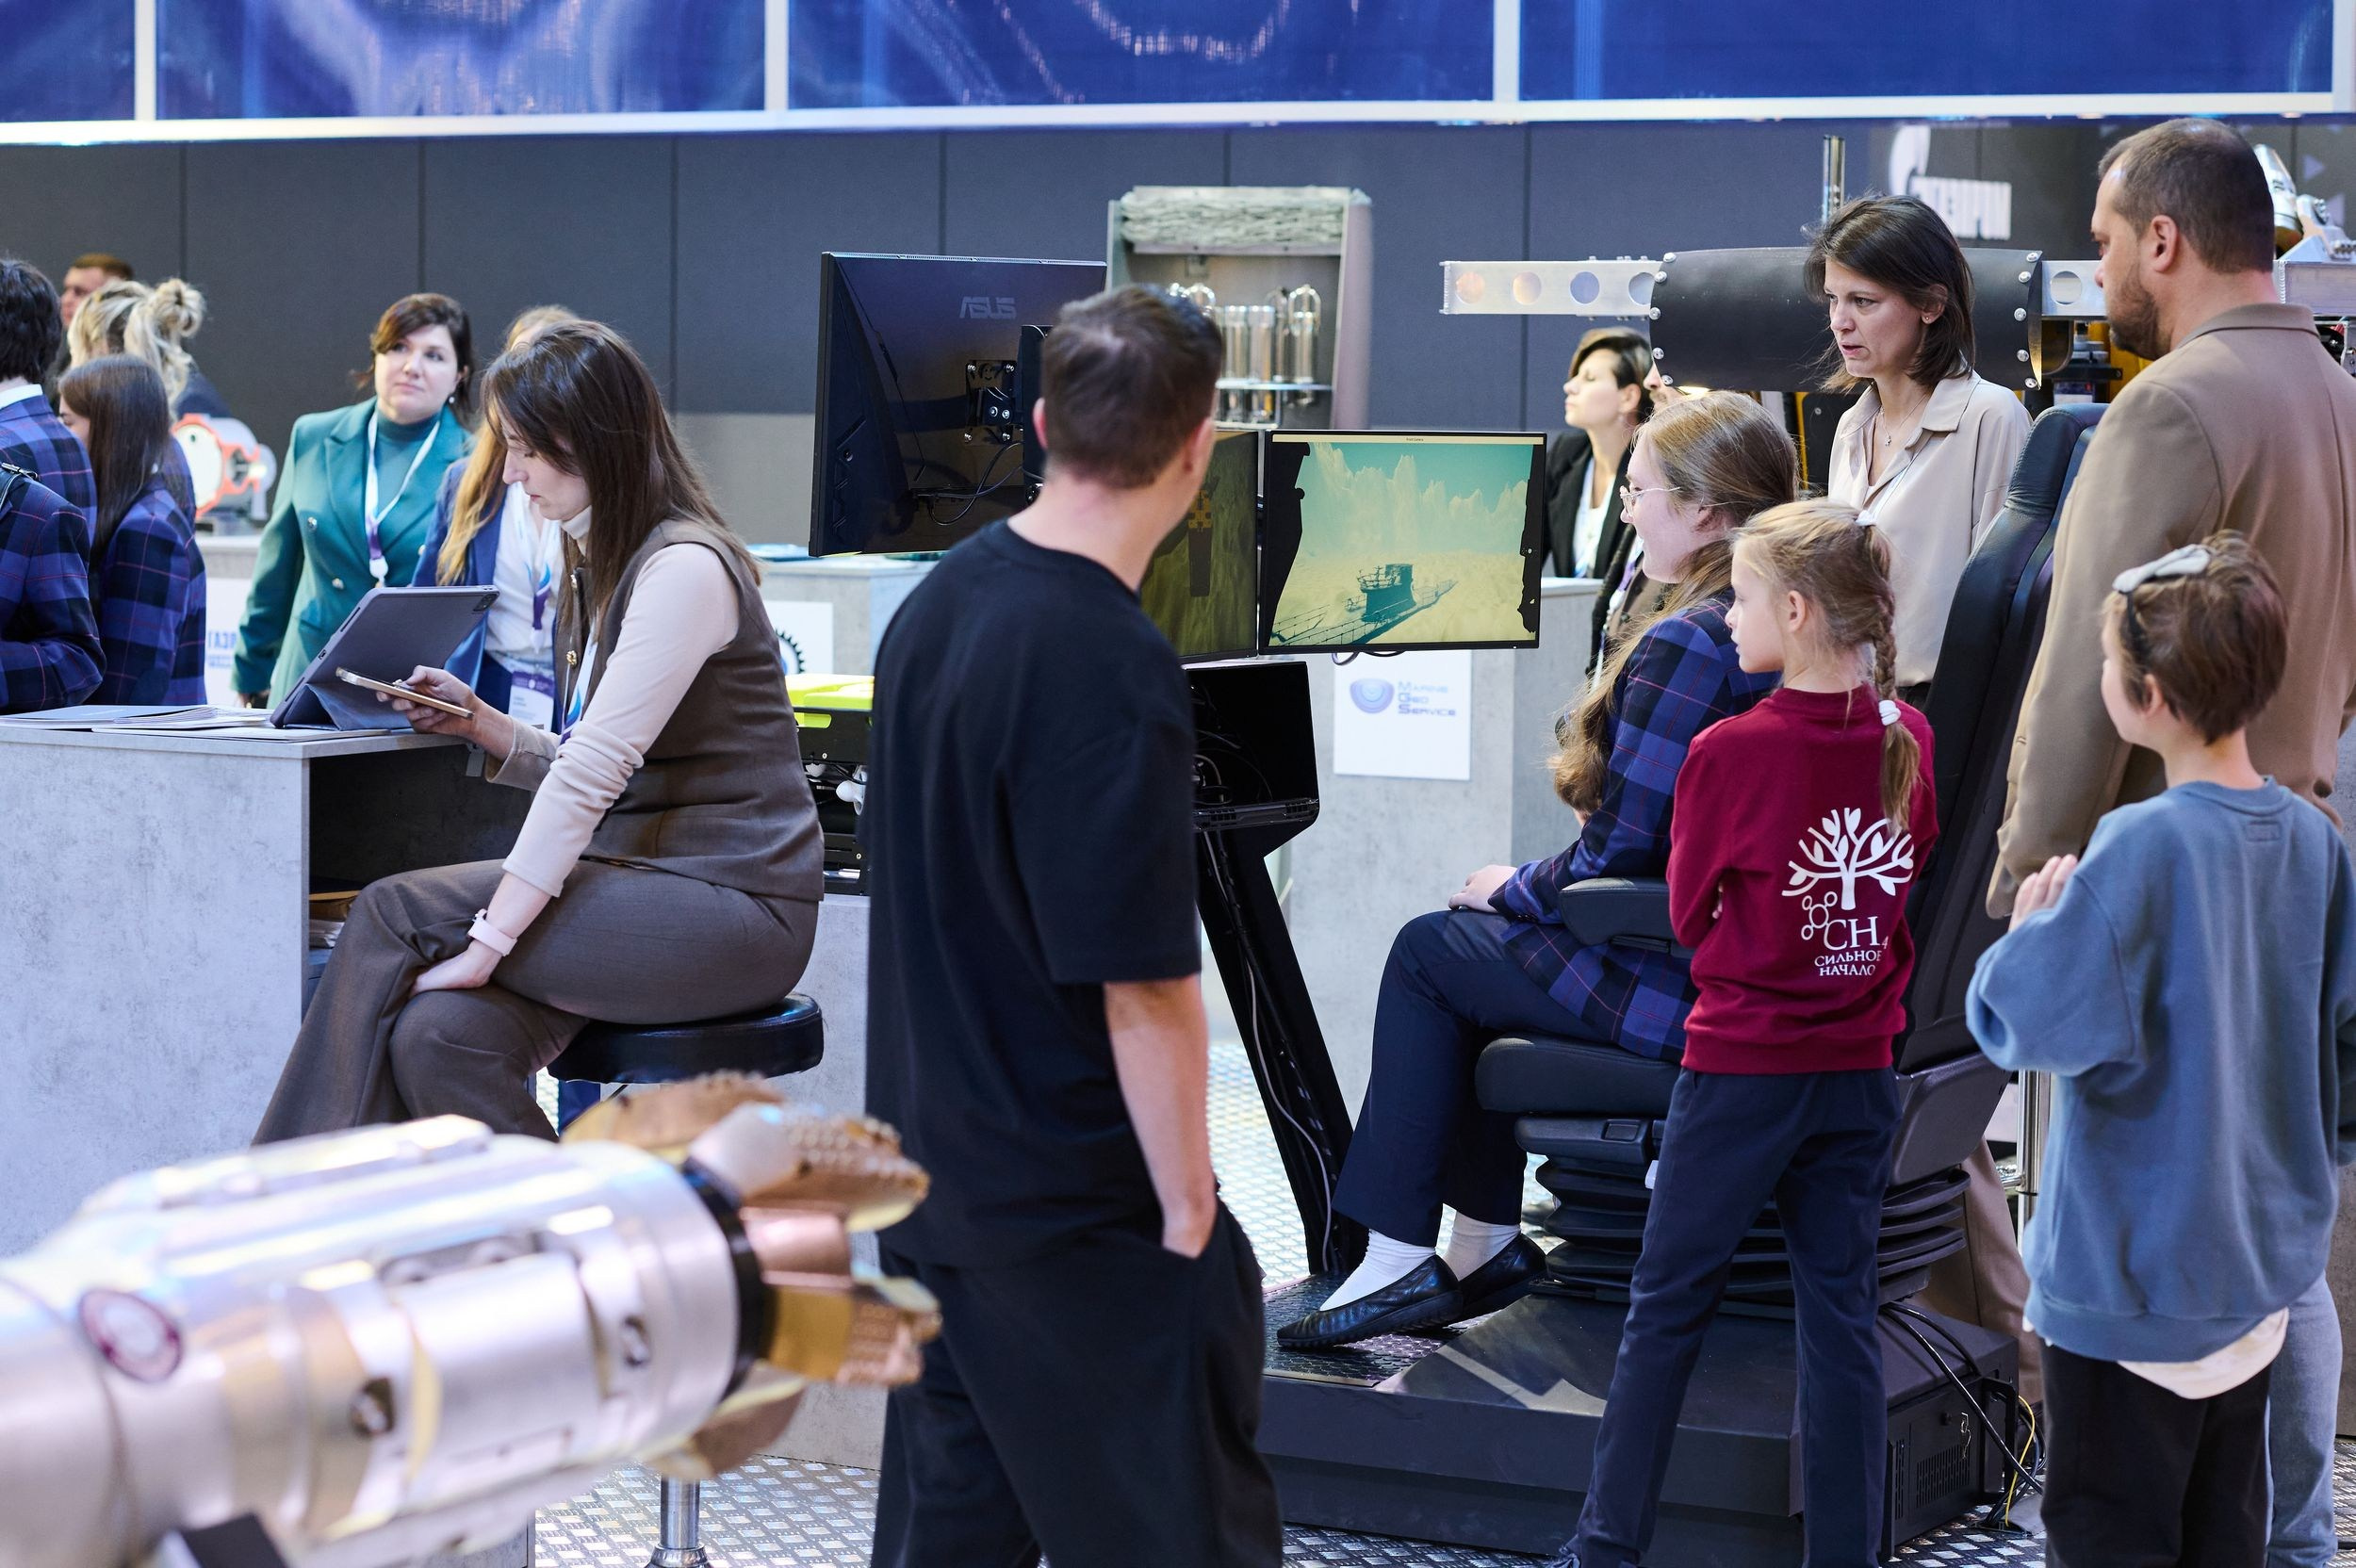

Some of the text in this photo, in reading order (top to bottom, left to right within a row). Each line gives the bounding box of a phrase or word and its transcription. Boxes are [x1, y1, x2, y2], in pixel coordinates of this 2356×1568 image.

[959, 296, 1017, 319] ASUS
[1814, 950, 1882, 967] СИЛЬНОЕ
[1819, 964, 1875, 976] НАЧАЛО
